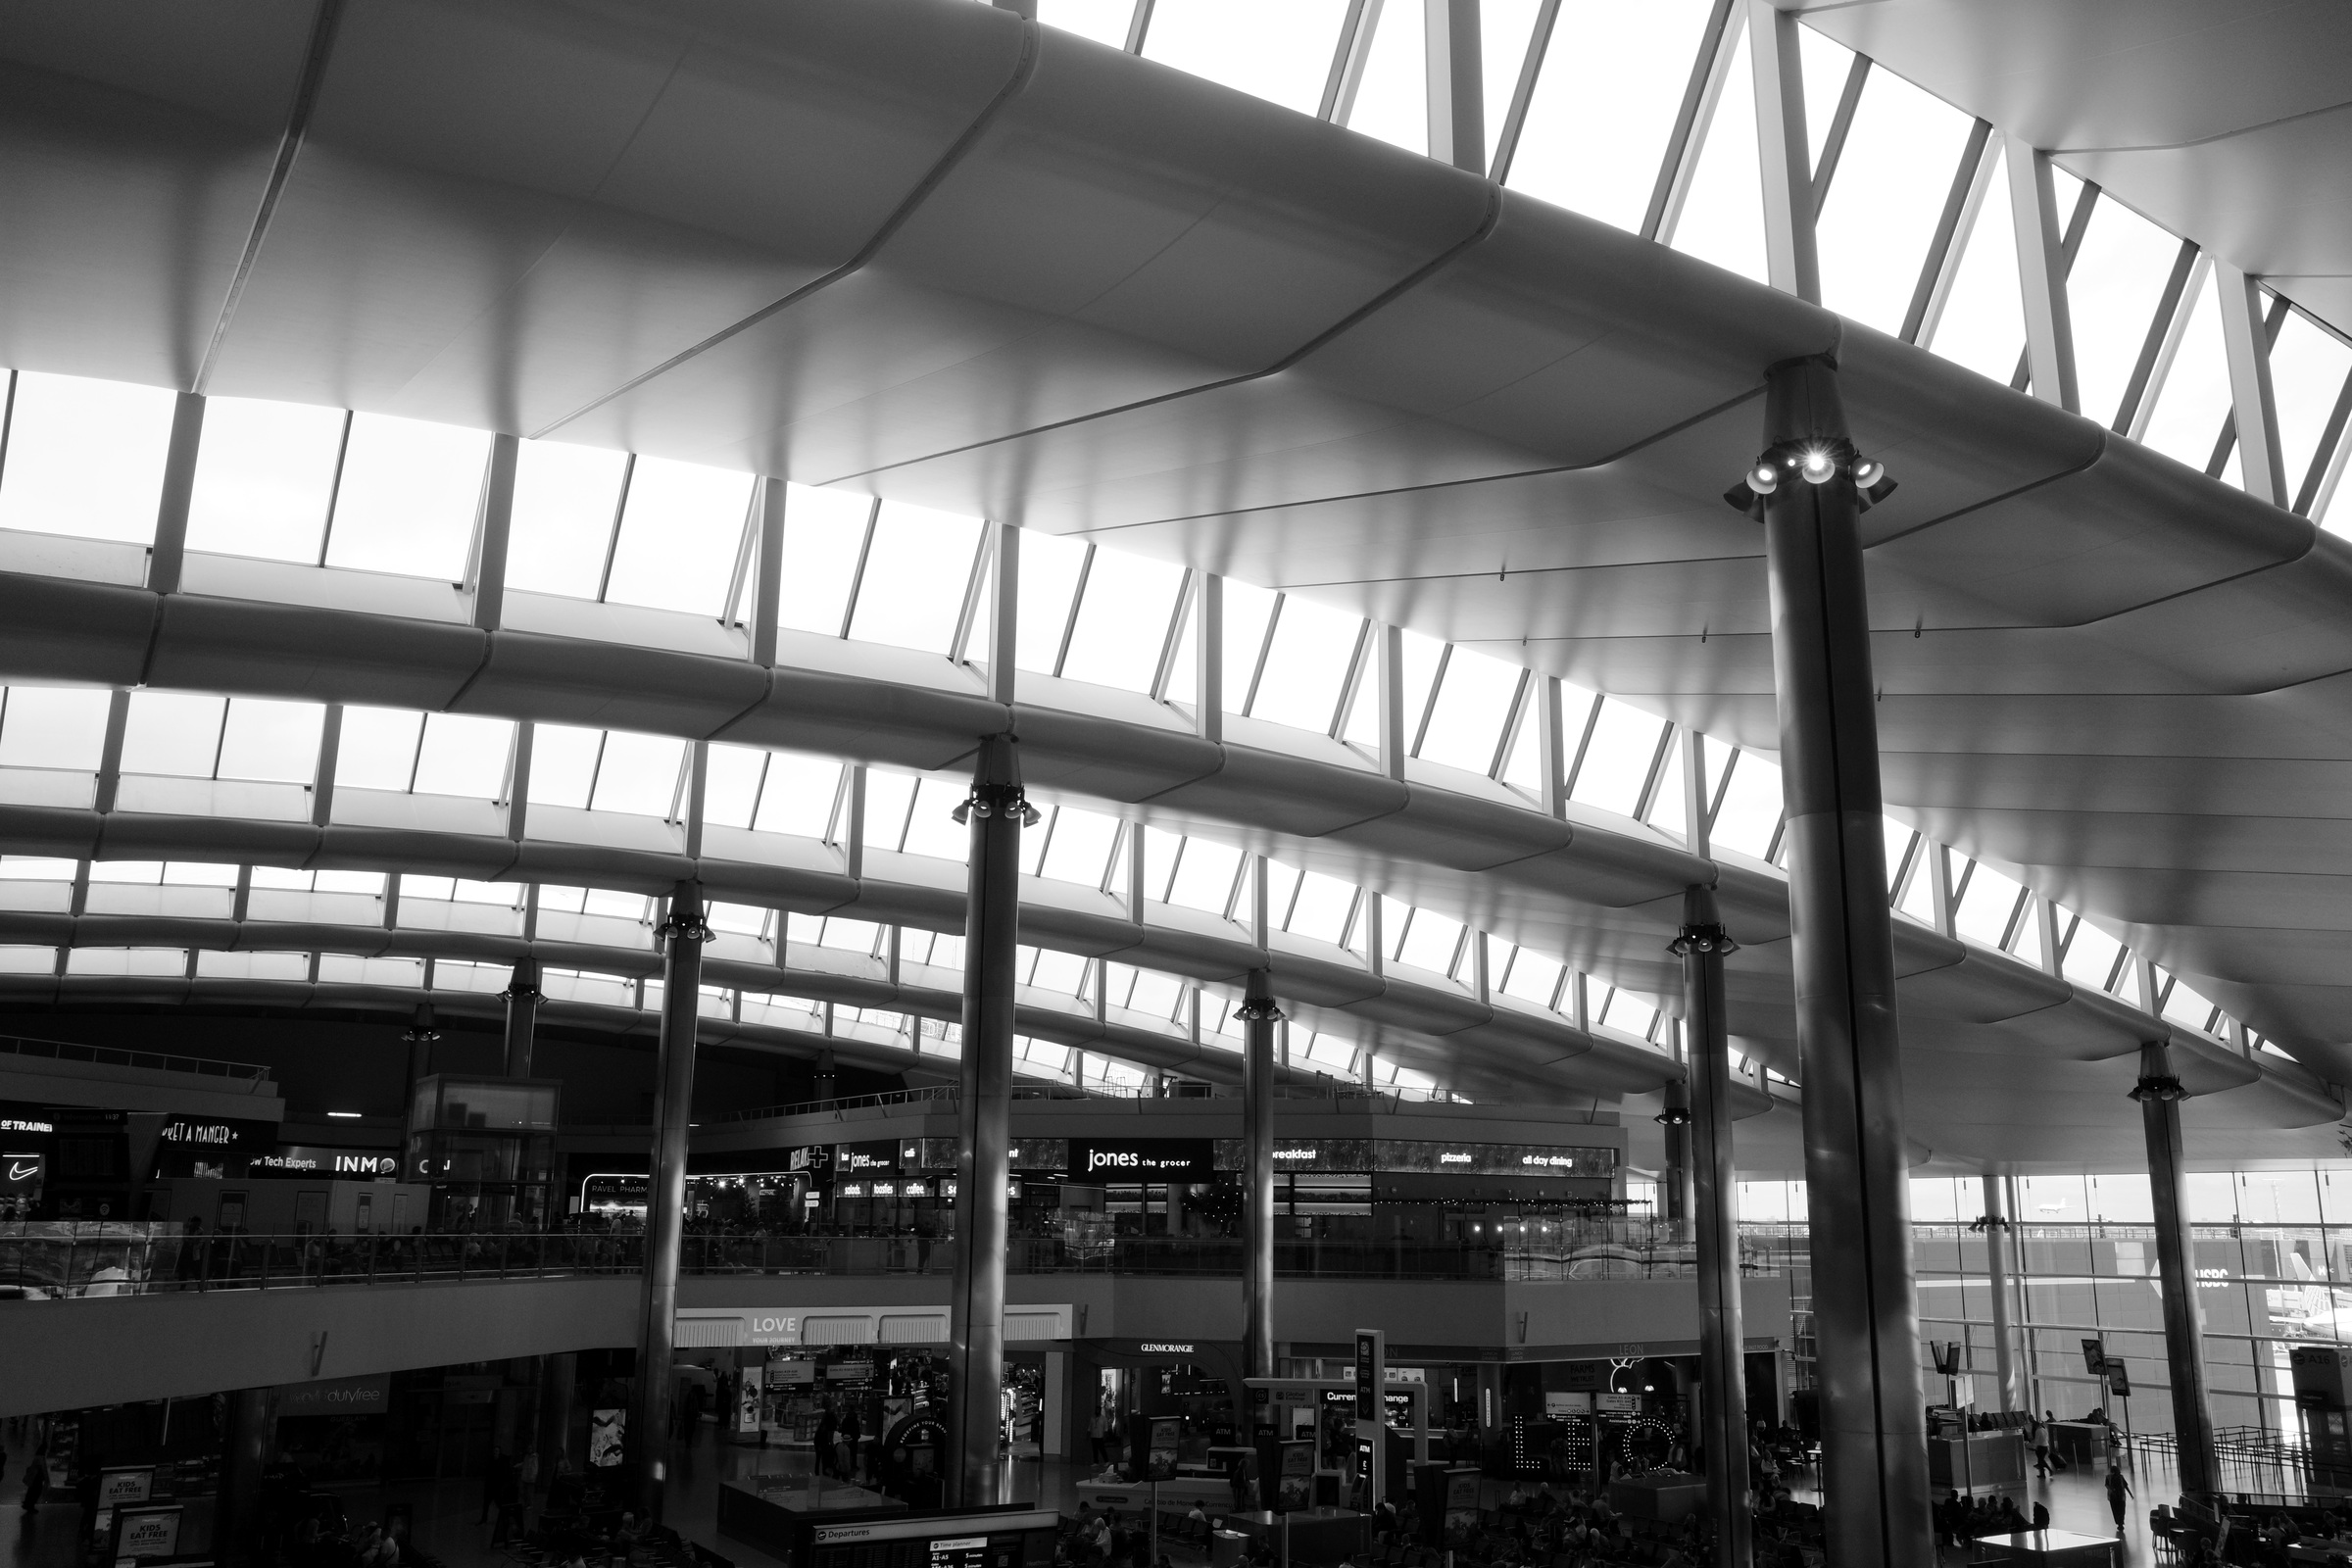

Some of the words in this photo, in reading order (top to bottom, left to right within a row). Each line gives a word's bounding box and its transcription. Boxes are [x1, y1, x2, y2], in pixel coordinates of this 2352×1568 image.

[185, 1125, 192, 1142] A
[195, 1125, 229, 1144] MANGER
[265, 1156, 283, 1166] Tech
[285, 1157, 316, 1169] Experts
[790, 1147, 809, 1171] RELAY
[851, 1152, 870, 1172] jones
[1088, 1149, 1139, 1172] jones
[1441, 1152, 1471, 1163] pizzeria
[1523, 1154, 1532, 1164] all
[1533, 1155, 1548, 1166] day
[1549, 1156, 1572, 1167] dining
[906, 1183, 924, 1195] coffee
[2195, 1268, 2229, 1288] HSBC
[754, 1317, 796, 1332] LOVE
[1141, 1344, 1194, 1352] GLENMORANGIE
[1619, 1344, 1643, 1355] LEON
[2309, 1355, 2330, 1364] A16
[1570, 1364, 1594, 1374] FARMS
[900, 1422, 919, 1444] REDEFINE
[936, 1423, 948, 1434] BEAU
[829, 1530, 870, 1539] Departures
